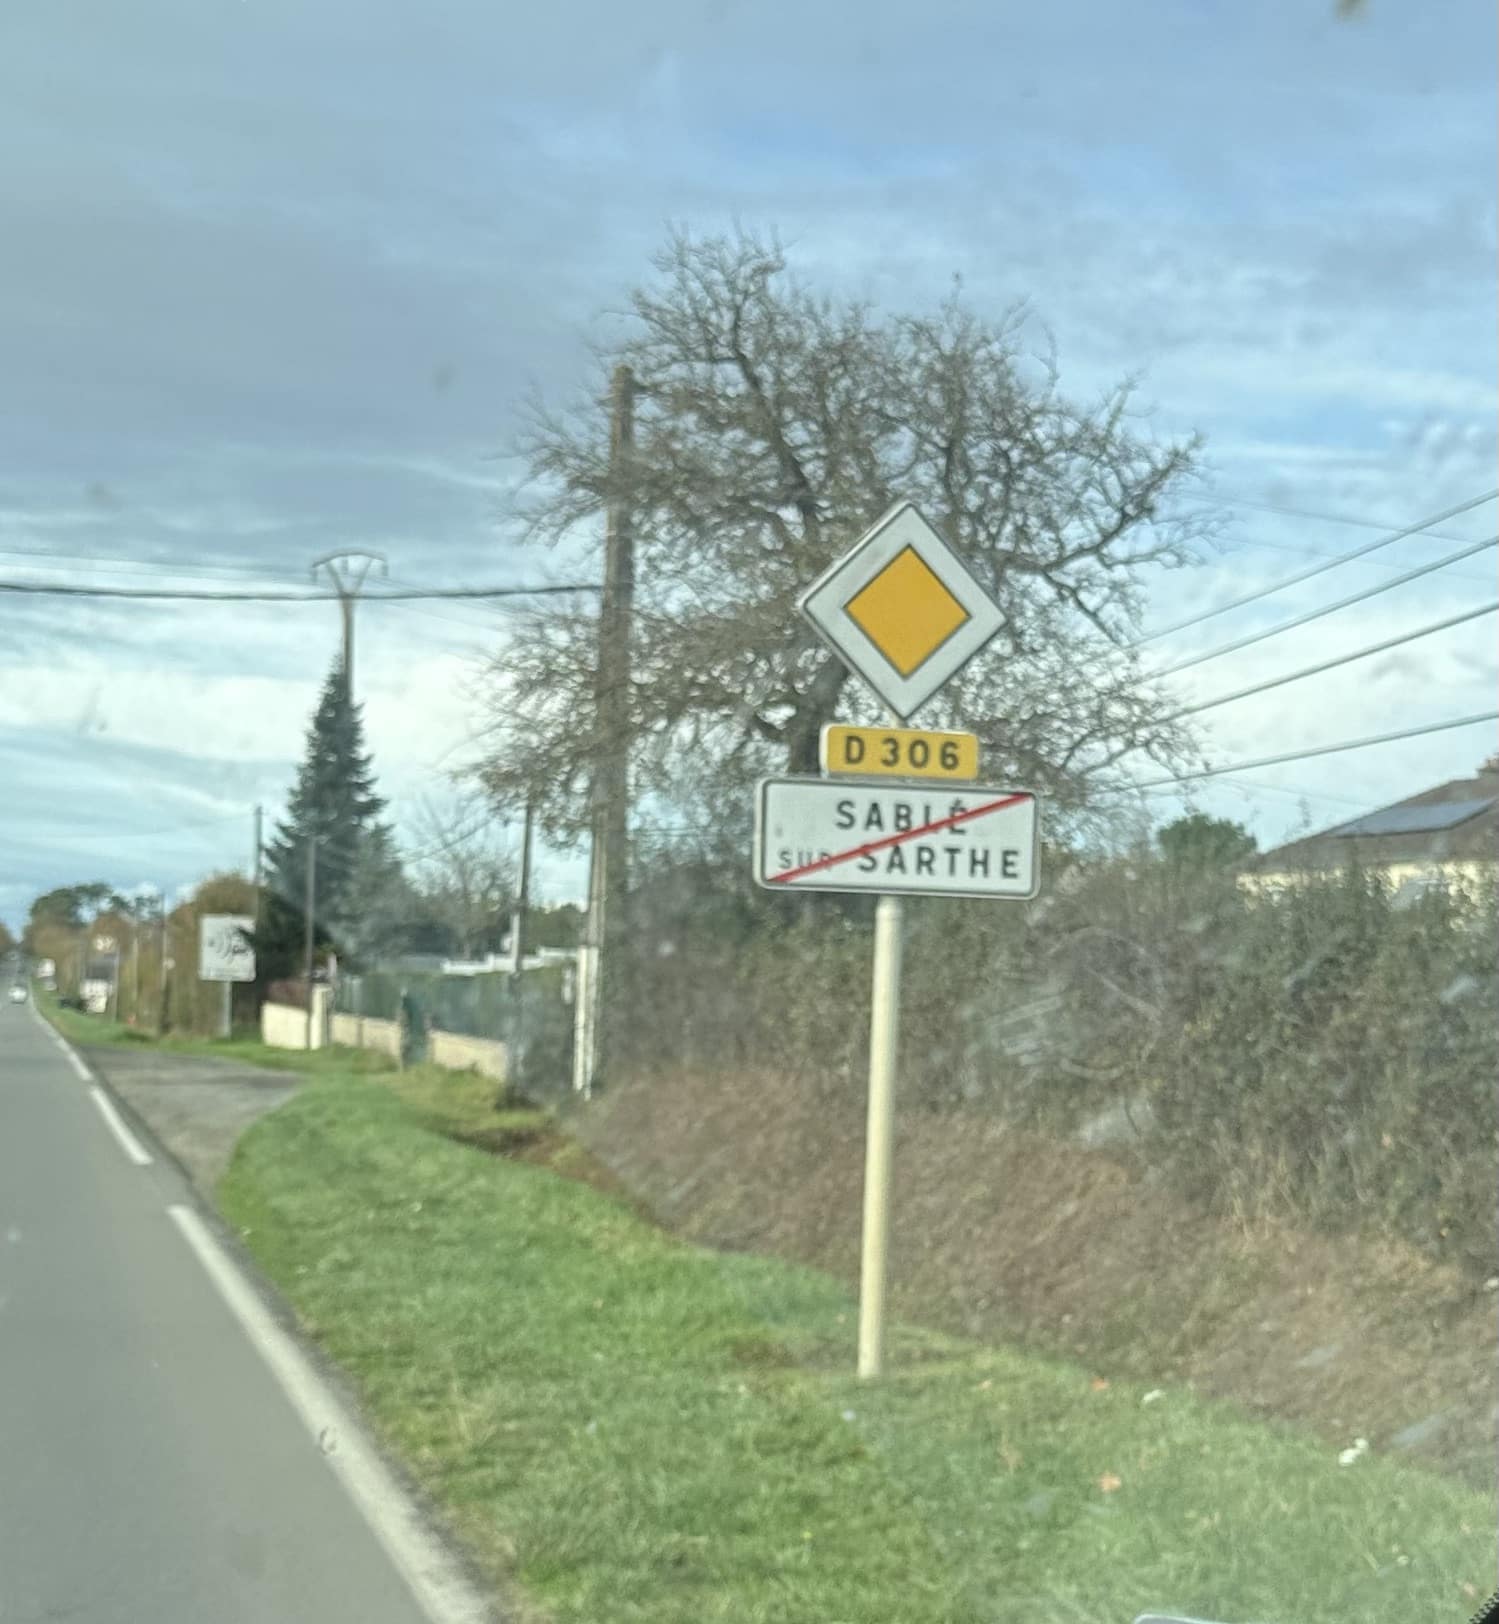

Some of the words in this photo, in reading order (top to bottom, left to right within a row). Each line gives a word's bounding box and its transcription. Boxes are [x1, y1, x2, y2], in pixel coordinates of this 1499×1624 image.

[844, 735, 865, 765] D
[880, 737, 960, 771] 306
[836, 797, 968, 836] SABLÉ
[857, 844, 1020, 880] SARTHE
